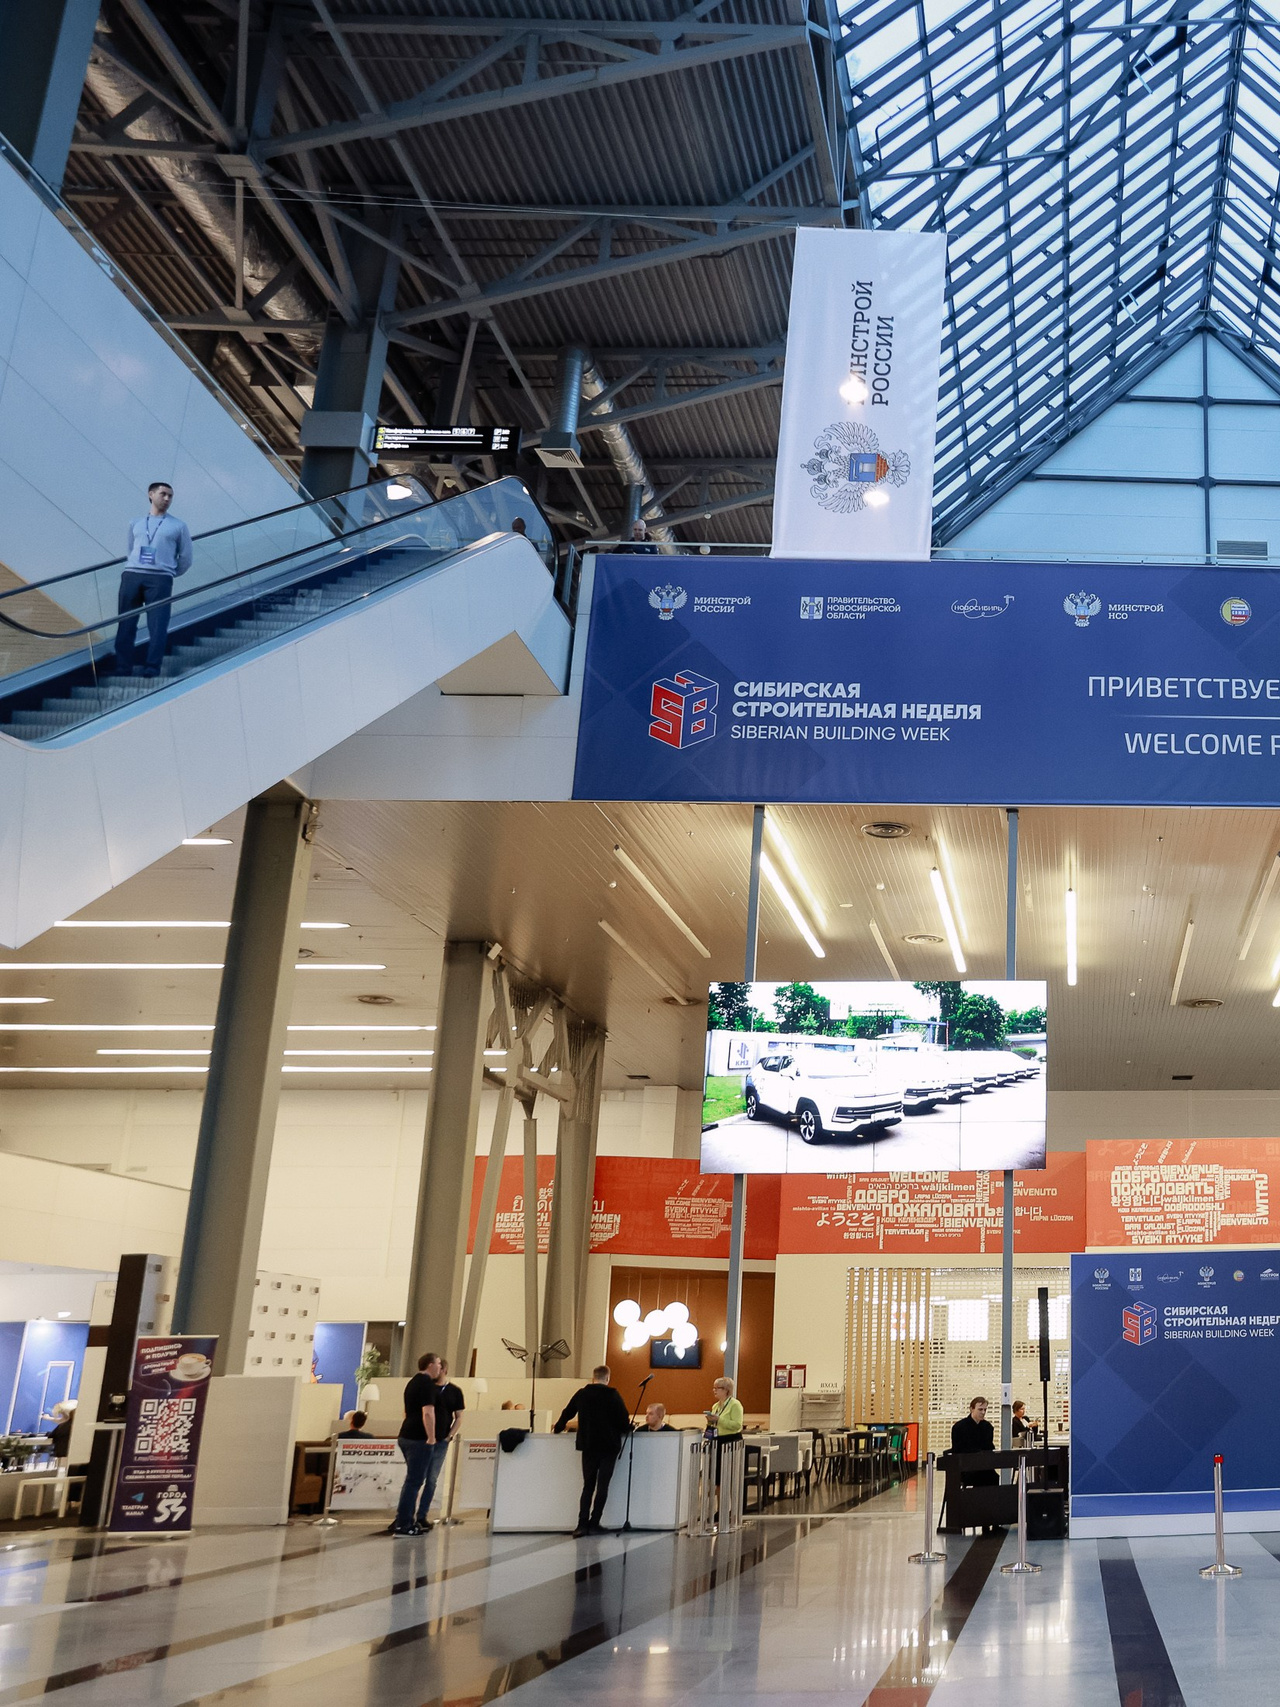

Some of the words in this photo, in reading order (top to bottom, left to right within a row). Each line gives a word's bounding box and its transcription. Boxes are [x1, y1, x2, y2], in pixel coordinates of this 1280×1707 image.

[848, 280, 873, 406] ИНСТРОЙ
[871, 315, 894, 406] РОССИИ
[693, 596, 751, 605] МИНСТРОЙ
[827, 596, 896, 605] ПРАВИТЕЛЬСТВО
[693, 605, 735, 613] РОССИИ
[826, 604, 901, 613] НОВОСИБИРСКОЙ
[1108, 603, 1164, 613] МИНСТРОЙ
[826, 612, 866, 620] ОБЛАСТИ
[1108, 612, 1128, 620] НСО
[733, 681, 861, 698] СИБИРСКАЯ
[732, 701, 896, 720] СТРОИТЕЛЬНАЯ
[902, 704, 982, 722] НЕДЕЛЯ
[730, 725, 808, 740] SIBERIAN
[813, 726, 896, 741] BUILDING
[901, 726, 951, 742] WEEK
[1124, 732, 1263, 756] WELCOME
[1160, 1164, 1220, 1175] BIENVENUE
[888, 1172, 950, 1183] WELCOME
[1110, 1170, 1160, 1183] ДОБРО
[1013, 1188, 1058, 1196] ENVENUTO
[1110, 1182, 1214, 1196] ПОЖАЛОВАТЬ
[854, 1190, 910, 1204] ДОБРО
[1110, 1195, 1165, 1207] 환영합니다
[1255, 1174, 1270, 1218] WITAJ
[881, 1202, 997, 1218] ПОЖАЛОВАТЬ
[1164, 1202, 1225, 1212] DOBRODOSHLI
[816, 1212, 876, 1227] ようこそ
[944, 1218, 1004, 1228] BIENVENUE
[1220, 1218, 1269, 1226] BENVENUTO
[1132, 1235, 1162, 1244] SVEIKI
[1166, 1234, 1204, 1244] ATVYKE
[1164, 1305, 1228, 1316] СИБИРСКАЯ
[1164, 1316, 1247, 1327] СТРОИТЕЛЬНАЯ
[1164, 1330, 1204, 1339] SIBERIAN
[1206, 1329, 1248, 1338] BUILDING
[1249, 1328, 1275, 1337] WEEK
[141, 1343, 182, 1354] ПОДПИШИСЬ
[154, 1498, 187, 1524] 54
